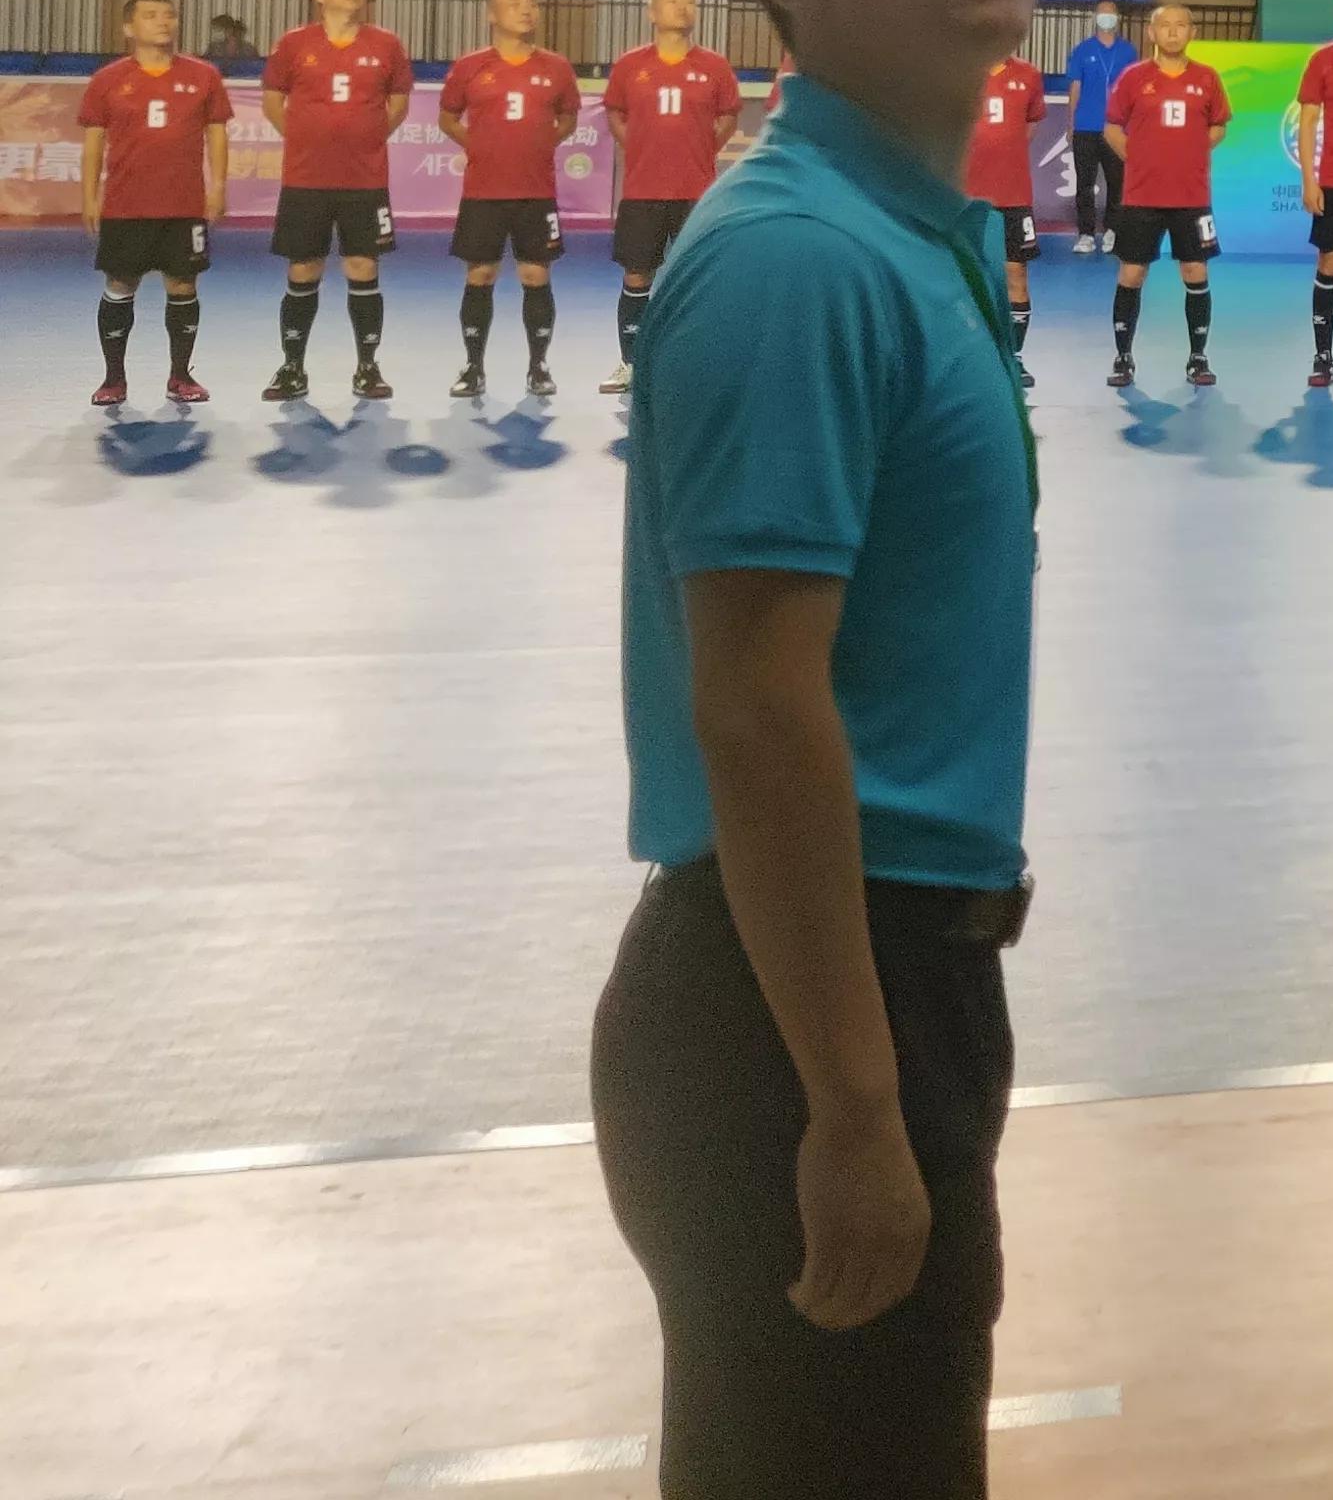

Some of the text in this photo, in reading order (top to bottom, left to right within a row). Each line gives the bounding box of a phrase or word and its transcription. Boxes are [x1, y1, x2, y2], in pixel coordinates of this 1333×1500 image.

[332, 73, 350, 102] 5
[658, 86, 682, 115] 11
[147, 99, 168, 129] 6
[505, 91, 524, 121] 3
[988, 97, 1005, 124] 9
[1162, 100, 1186, 127] 13
[1271, 200, 1305, 212] SHA
[376, 207, 393, 236] 5
[546, 211, 560, 240] 3
[1021, 215, 1036, 242] 9
[191, 224, 206, 253] 6
